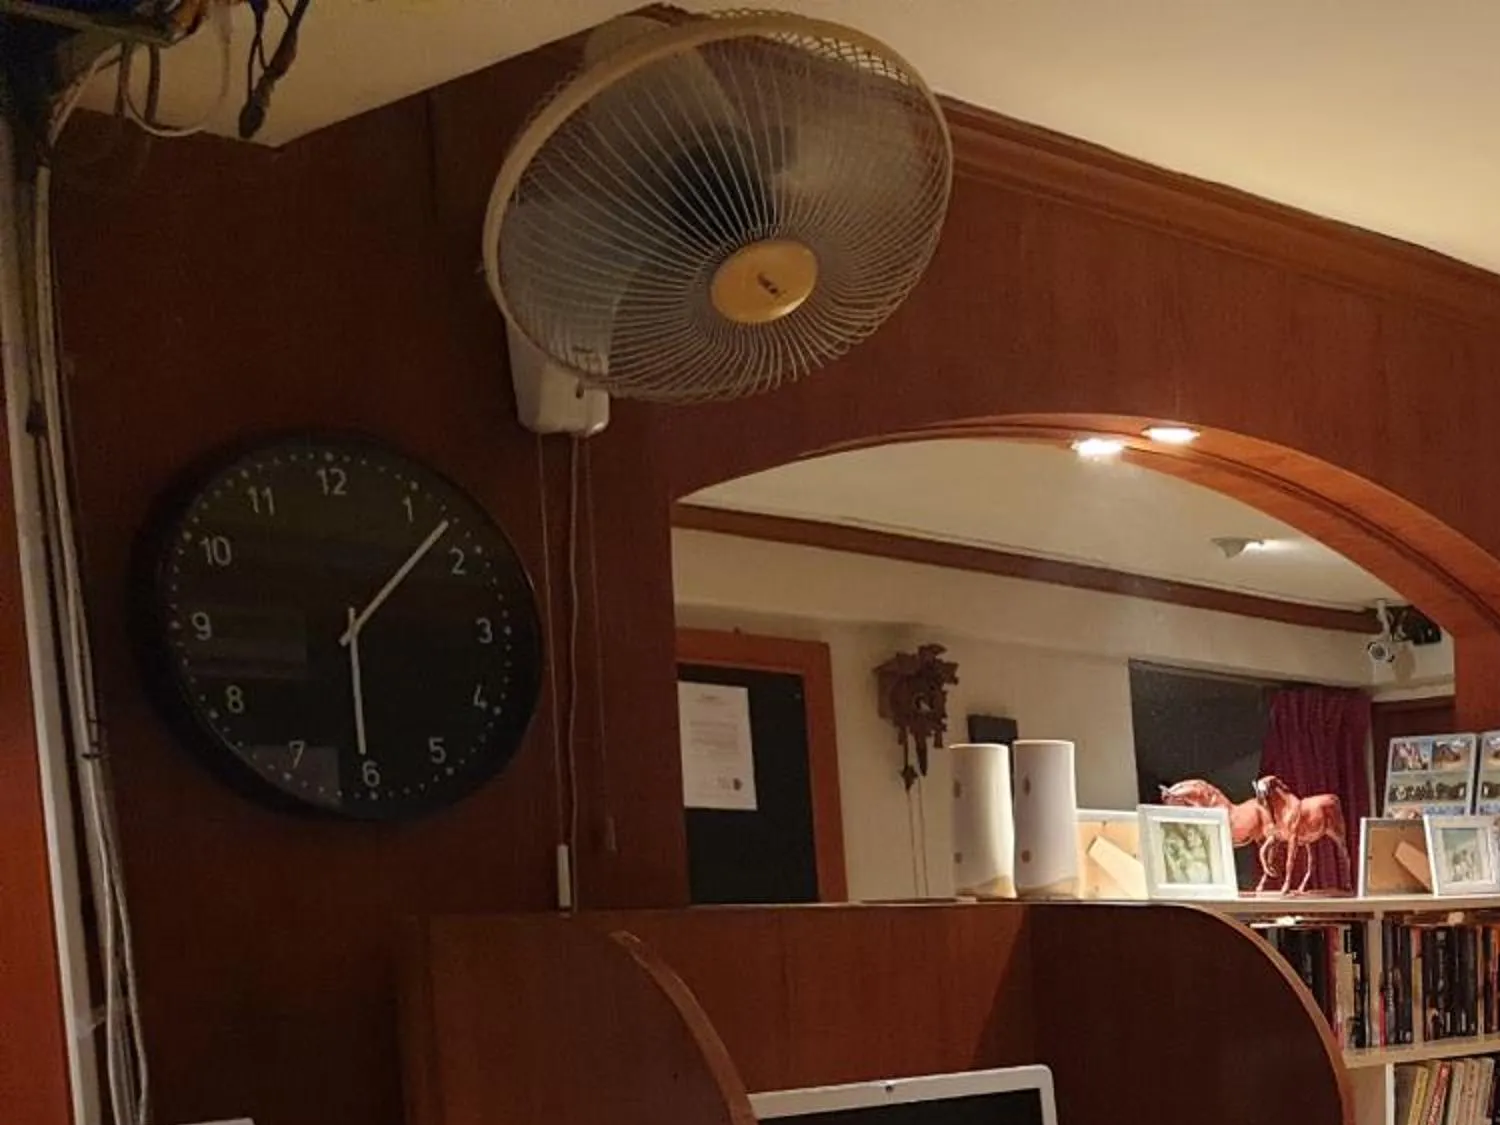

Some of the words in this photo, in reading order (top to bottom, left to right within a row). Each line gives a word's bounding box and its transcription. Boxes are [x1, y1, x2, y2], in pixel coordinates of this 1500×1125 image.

[316, 468, 347, 496] 12
[247, 486, 276, 516] 11
[401, 497, 415, 522] 1
[200, 535, 232, 566] 10
[449, 548, 466, 576] 2
[191, 610, 213, 641] 9
[476, 617, 494, 644] 3
[225, 684, 245, 714] 8
[473, 684, 488, 711] 4
[288, 740, 306, 769] 7
[428, 737, 448, 764] 5
[361, 760, 381, 788] 6
